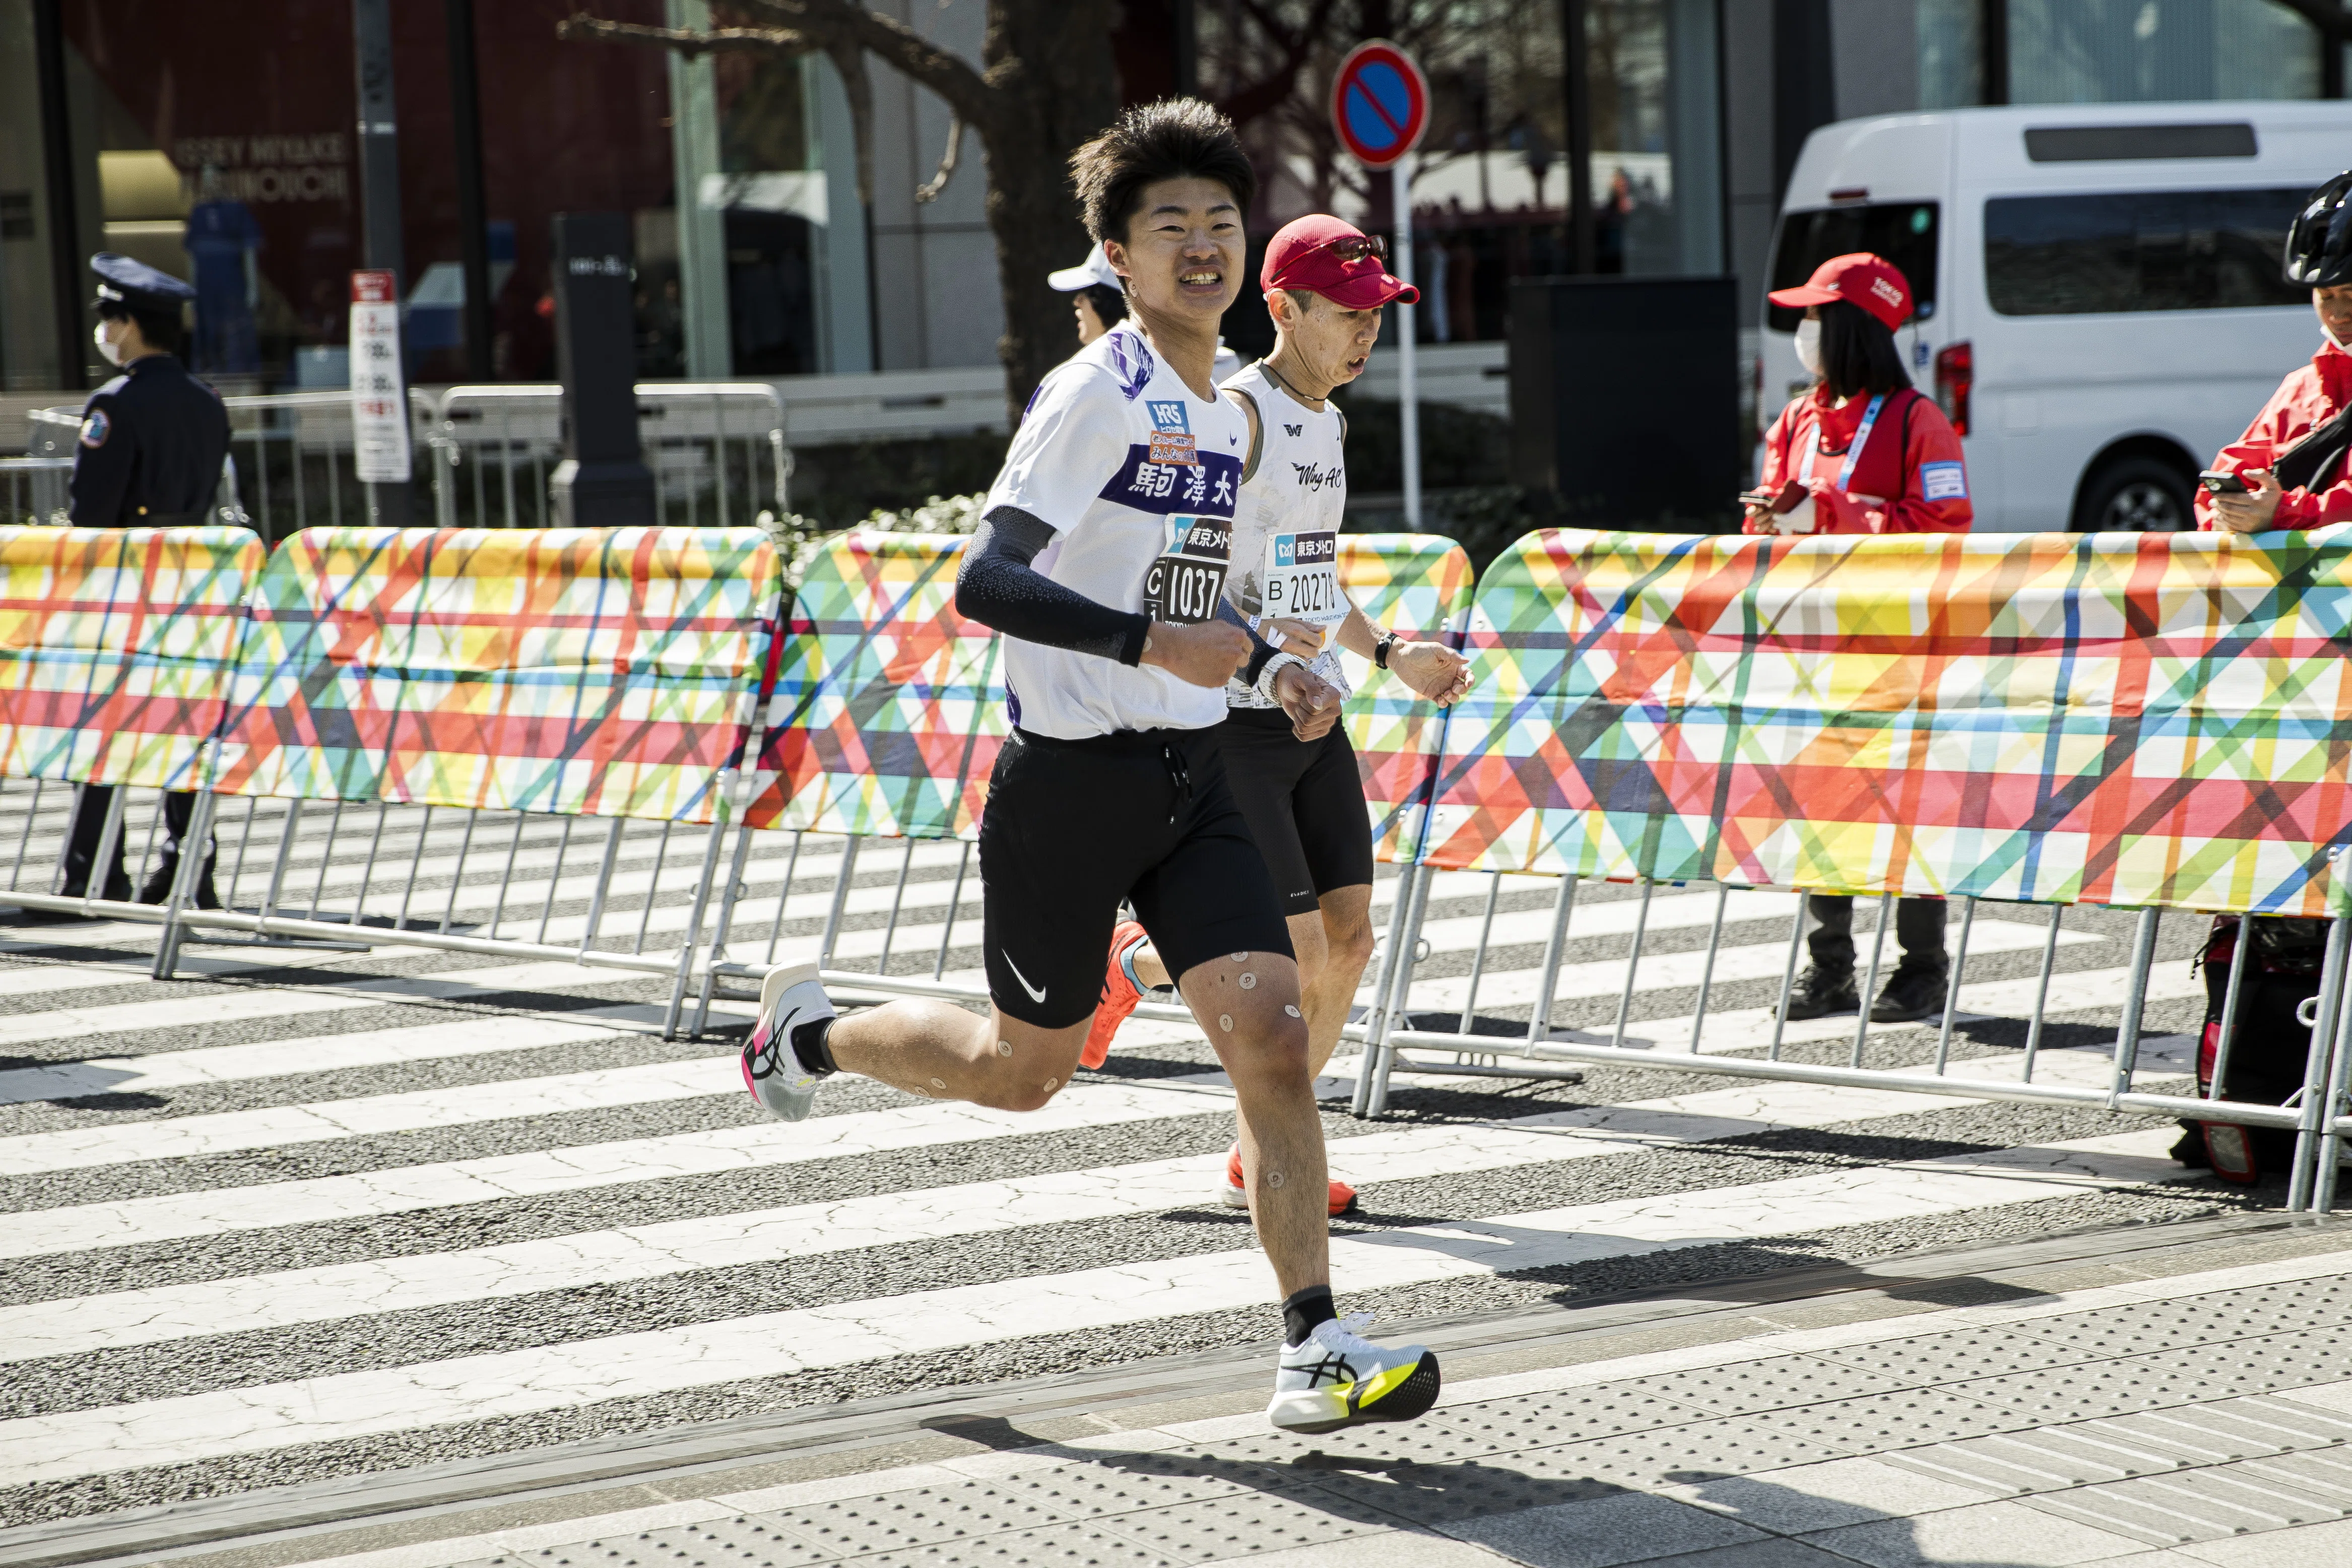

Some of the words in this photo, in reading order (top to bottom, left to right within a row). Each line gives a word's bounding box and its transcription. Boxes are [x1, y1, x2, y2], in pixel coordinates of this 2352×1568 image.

[1152, 404, 1182, 424] HRS
[1128, 462, 1243, 507] 駒澤大
[1291, 462, 1323, 492] Wing
[1325, 467, 1343, 488] AC
[1188, 527, 1232, 550] 東京メトロ
[1297, 540, 1334, 557] 東京メトロ
[1147, 567, 1162, 595] C
[1169, 565, 1219, 619] 1037
[1269, 580, 1282, 601] B
[1291, 572, 1335, 613] 20278
